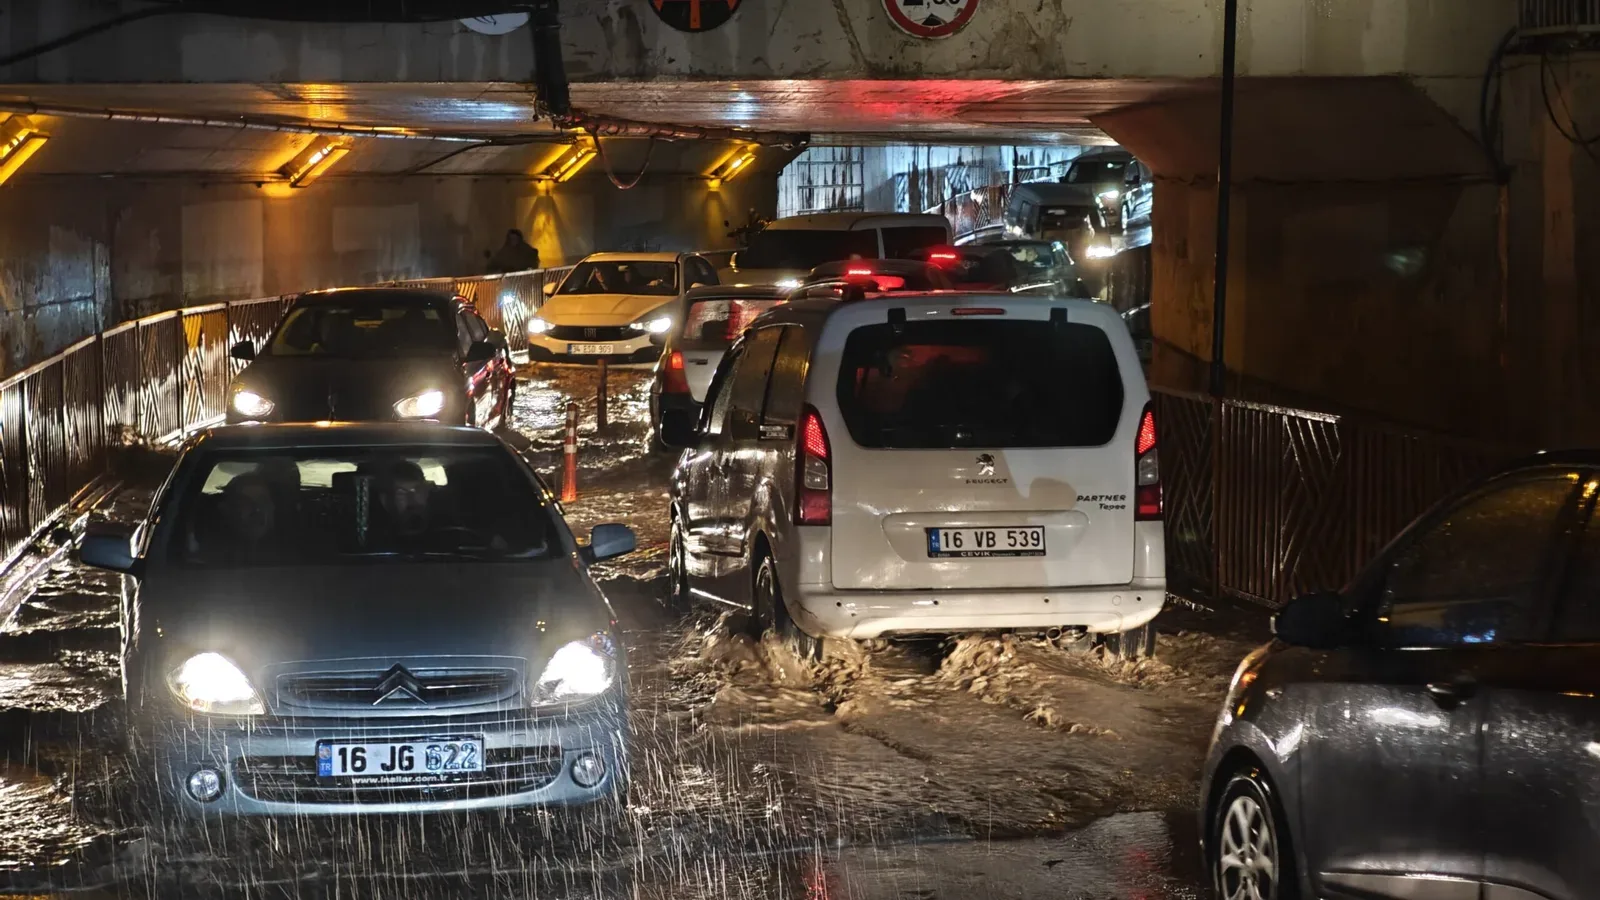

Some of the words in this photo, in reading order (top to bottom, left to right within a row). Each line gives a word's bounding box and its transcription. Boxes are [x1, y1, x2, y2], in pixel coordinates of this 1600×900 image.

[1076, 494, 1127, 502] PARTNER
[1099, 503, 1126, 511] Tepee
[943, 531, 963, 548] 16
[974, 531, 996, 548] VB
[1007, 530, 1040, 547] 539
[320, 762, 331, 771] TR
[338, 746, 367, 773] 16
[380, 745, 415, 772] JG
[425, 742, 478, 771] 622
